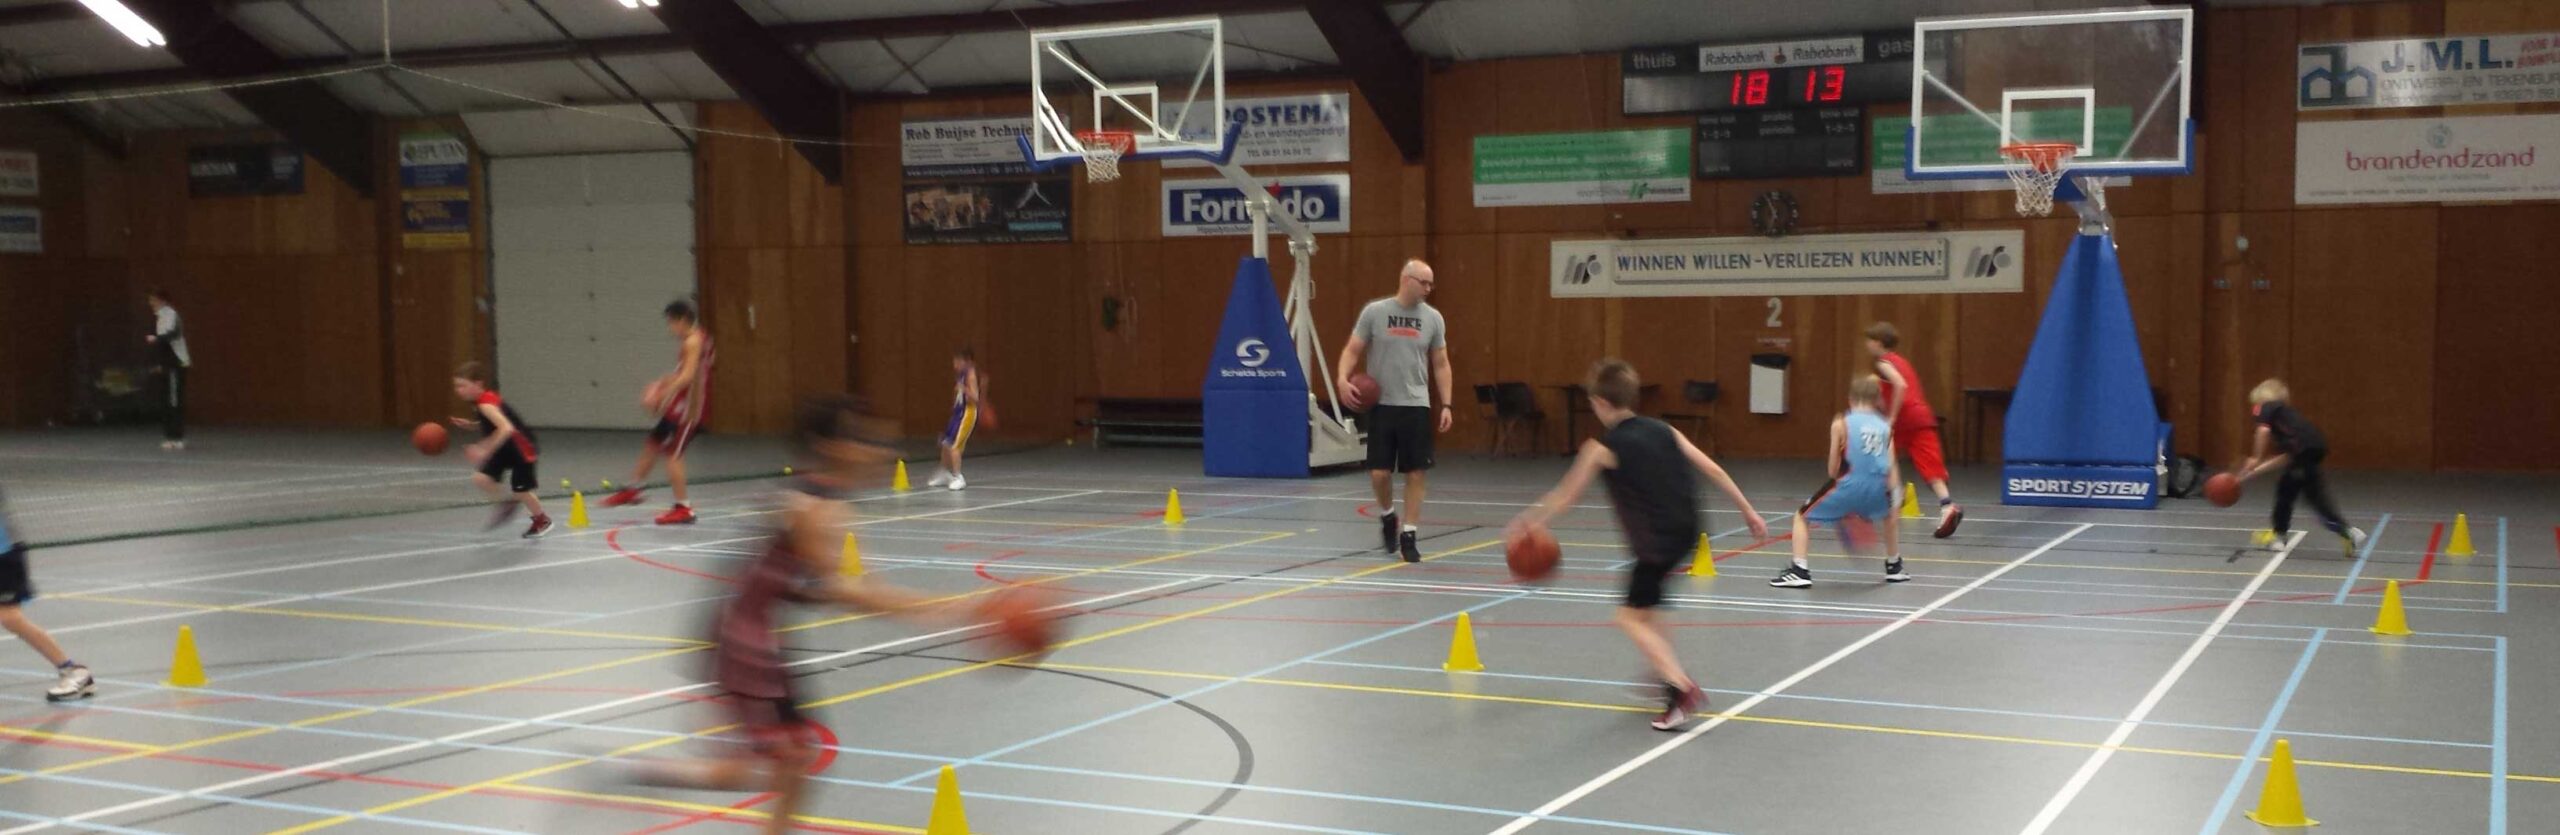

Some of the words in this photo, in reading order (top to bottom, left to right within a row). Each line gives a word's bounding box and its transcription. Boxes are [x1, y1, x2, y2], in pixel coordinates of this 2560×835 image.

[1632, 52, 1677, 70] thuis
[1705, 49, 1766, 66] Rabobank
[1792, 44, 1857, 61] Rabobank
[1730, 71, 1770, 106] 18
[1804, 65, 1847, 102] 13
[982, 123, 1034, 138] Technie
[2345, 145, 2536, 171] brandendzand
[1617, 254, 1686, 272] WINNEN
[1859, 249, 1943, 269] KUNNEN!
[1766, 297, 1783, 328] 2
[1387, 315, 1422, 331] NIKE
